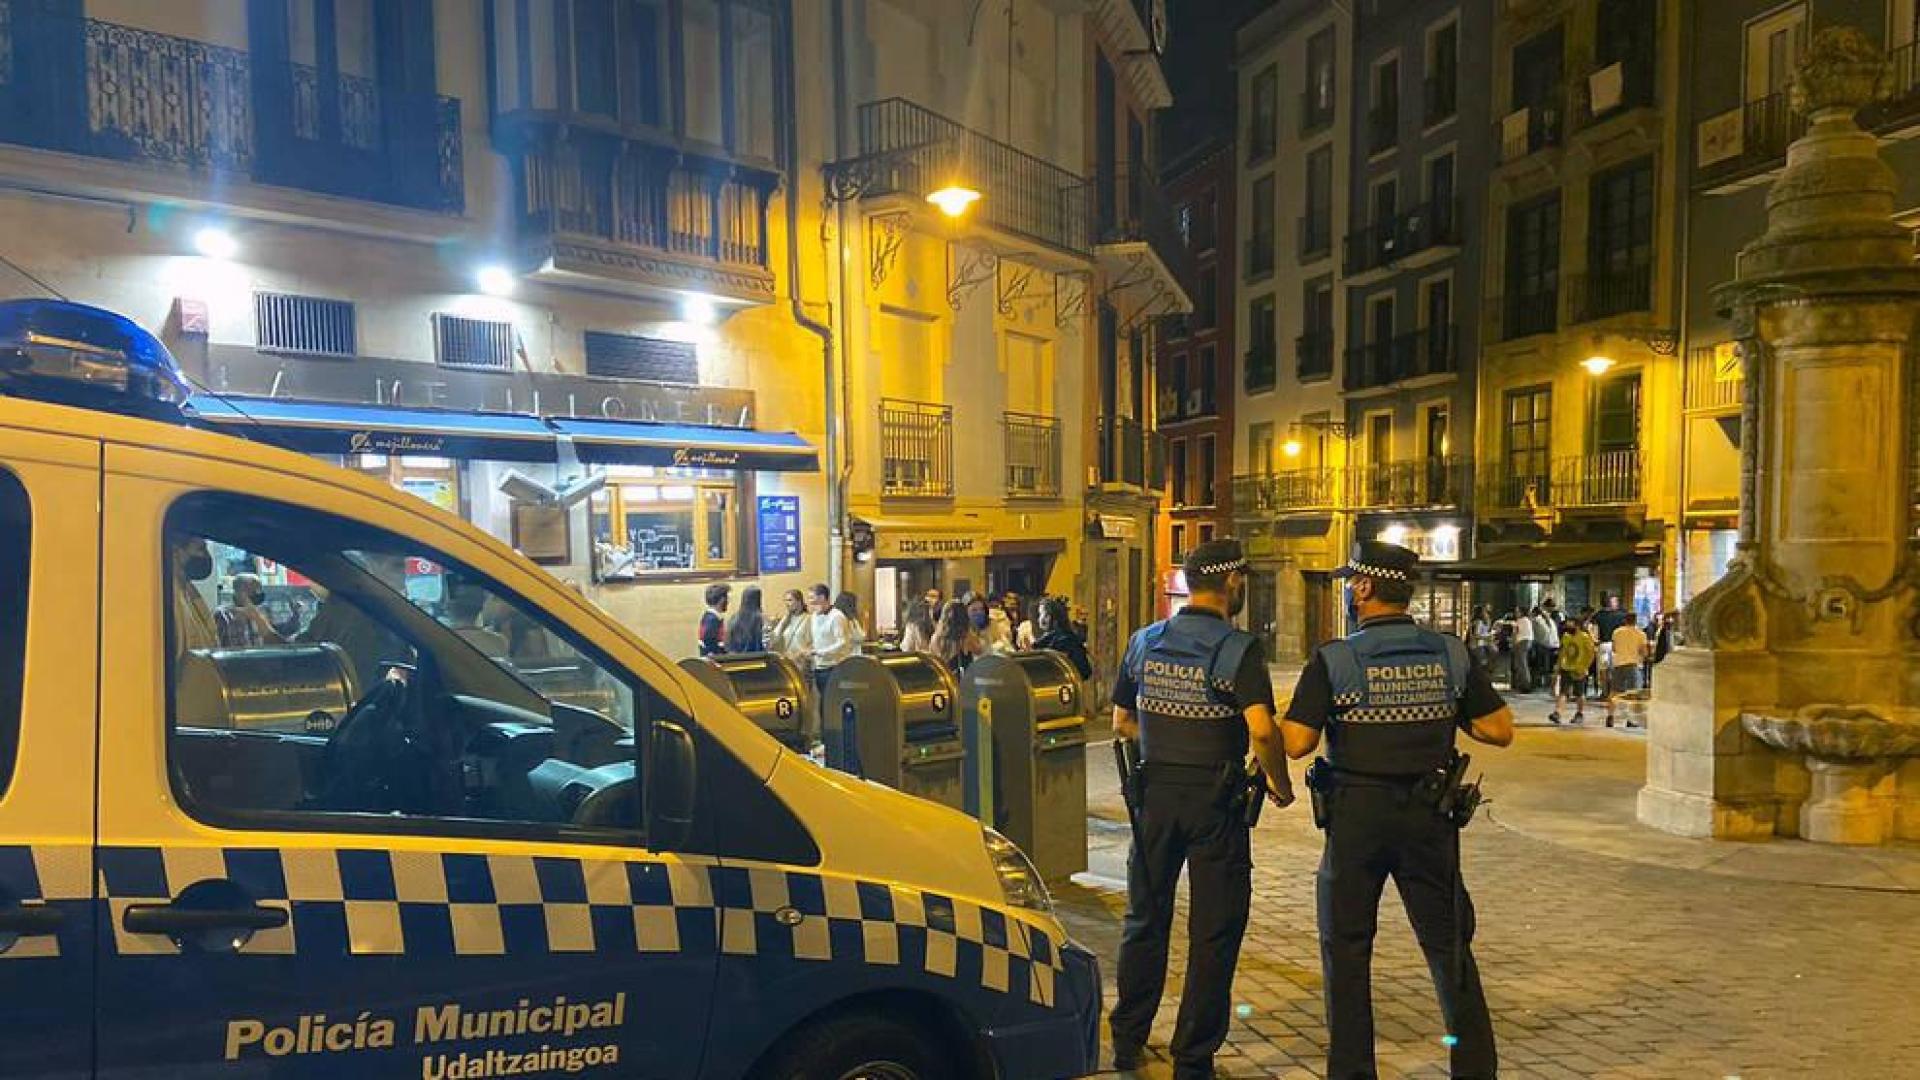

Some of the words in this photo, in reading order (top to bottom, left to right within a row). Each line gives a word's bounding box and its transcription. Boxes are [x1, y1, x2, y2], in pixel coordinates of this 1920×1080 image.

[1368, 679, 1446, 692] MUNICIPAL
[225, 1012, 396, 1059] Policía
[414, 993, 626, 1042] Municipal
[422, 1043, 619, 1080] Udaltzaingoa
